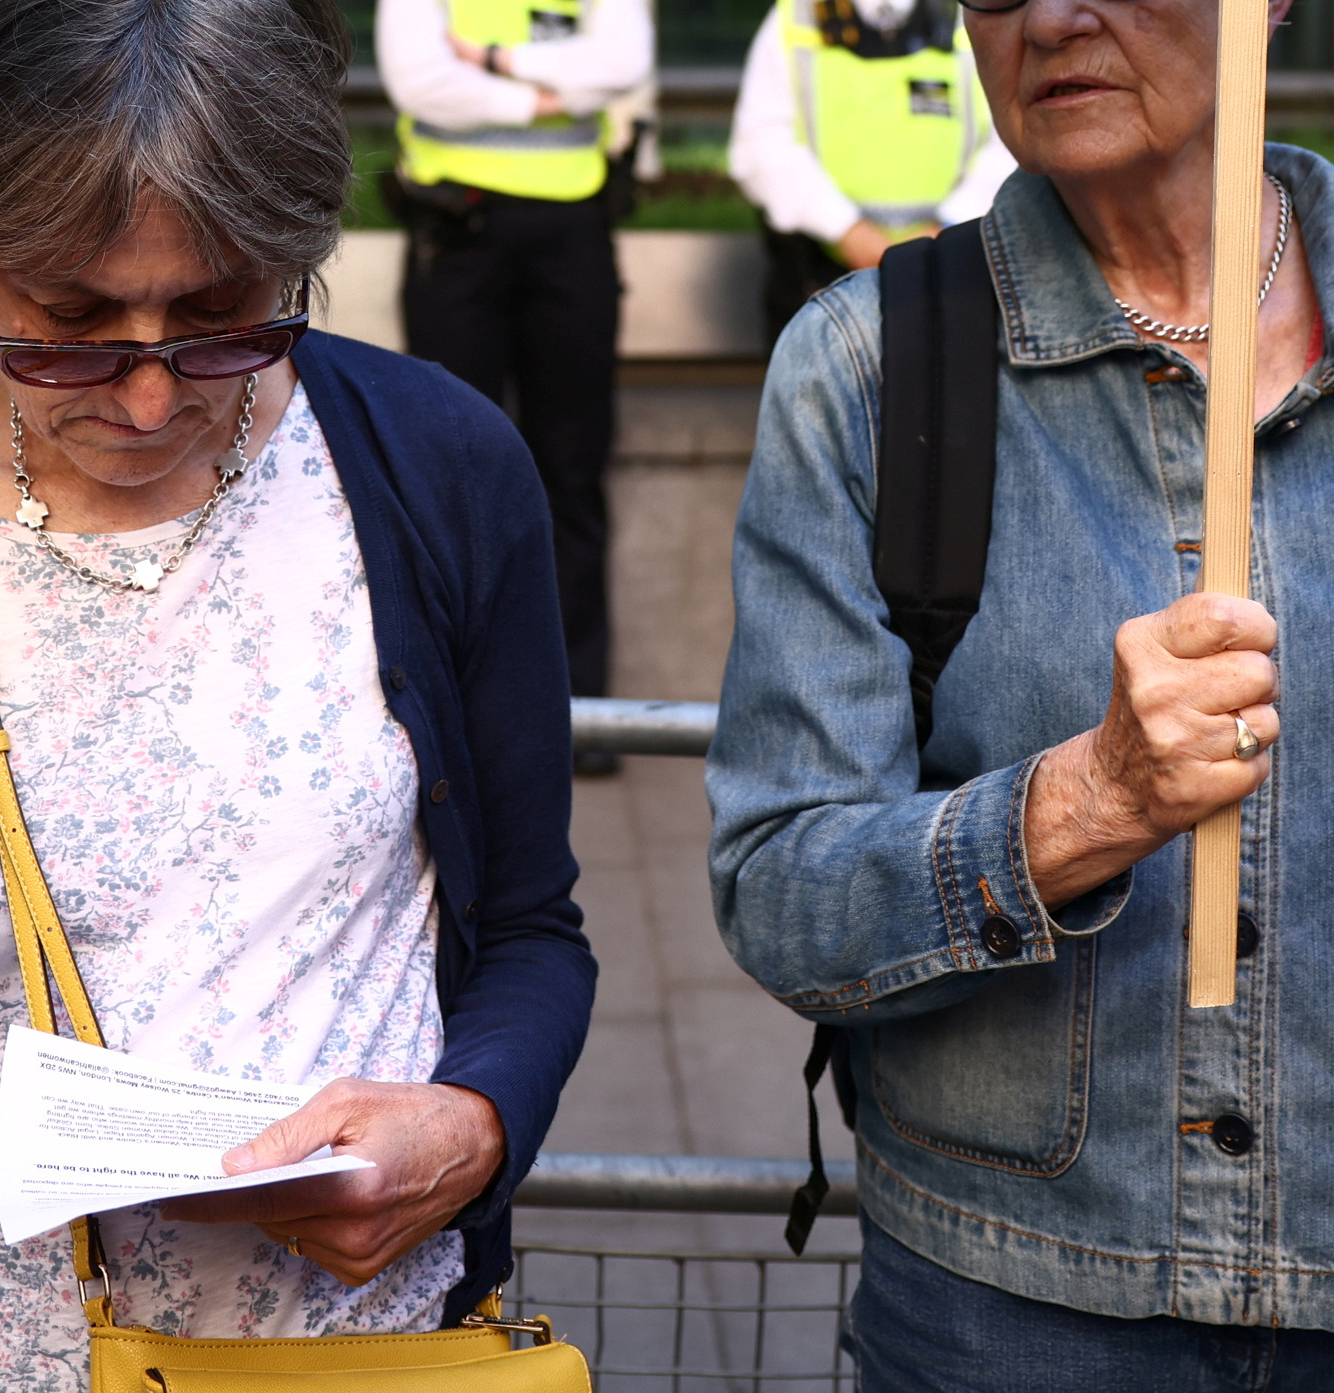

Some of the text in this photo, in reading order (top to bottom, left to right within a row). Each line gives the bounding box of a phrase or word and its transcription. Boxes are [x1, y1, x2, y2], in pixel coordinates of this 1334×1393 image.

[37, 1052, 109, 1074] @allafricanwomen
[40, 1062, 56, 1071] 2DX
[58, 1066, 77, 1075] NW5
[79, 1070, 111, 1083] London,
[111, 1069, 153, 1083] Facebook:
[113, 1077, 138, 1088] Mews,
[140, 1082, 169, 1093] Wolsey
[183, 1089, 212, 1098] Centre,
[215, 1094, 251, 1103] Women's
[254, 1099, 300, 1108] Crossroads
[47, 1110, 75, 1119] fighting
[108, 1112, 142, 1120] meetings
[47, 1118, 73, 1126] Global
[183, 1142, 227, 1150] Crossroads
